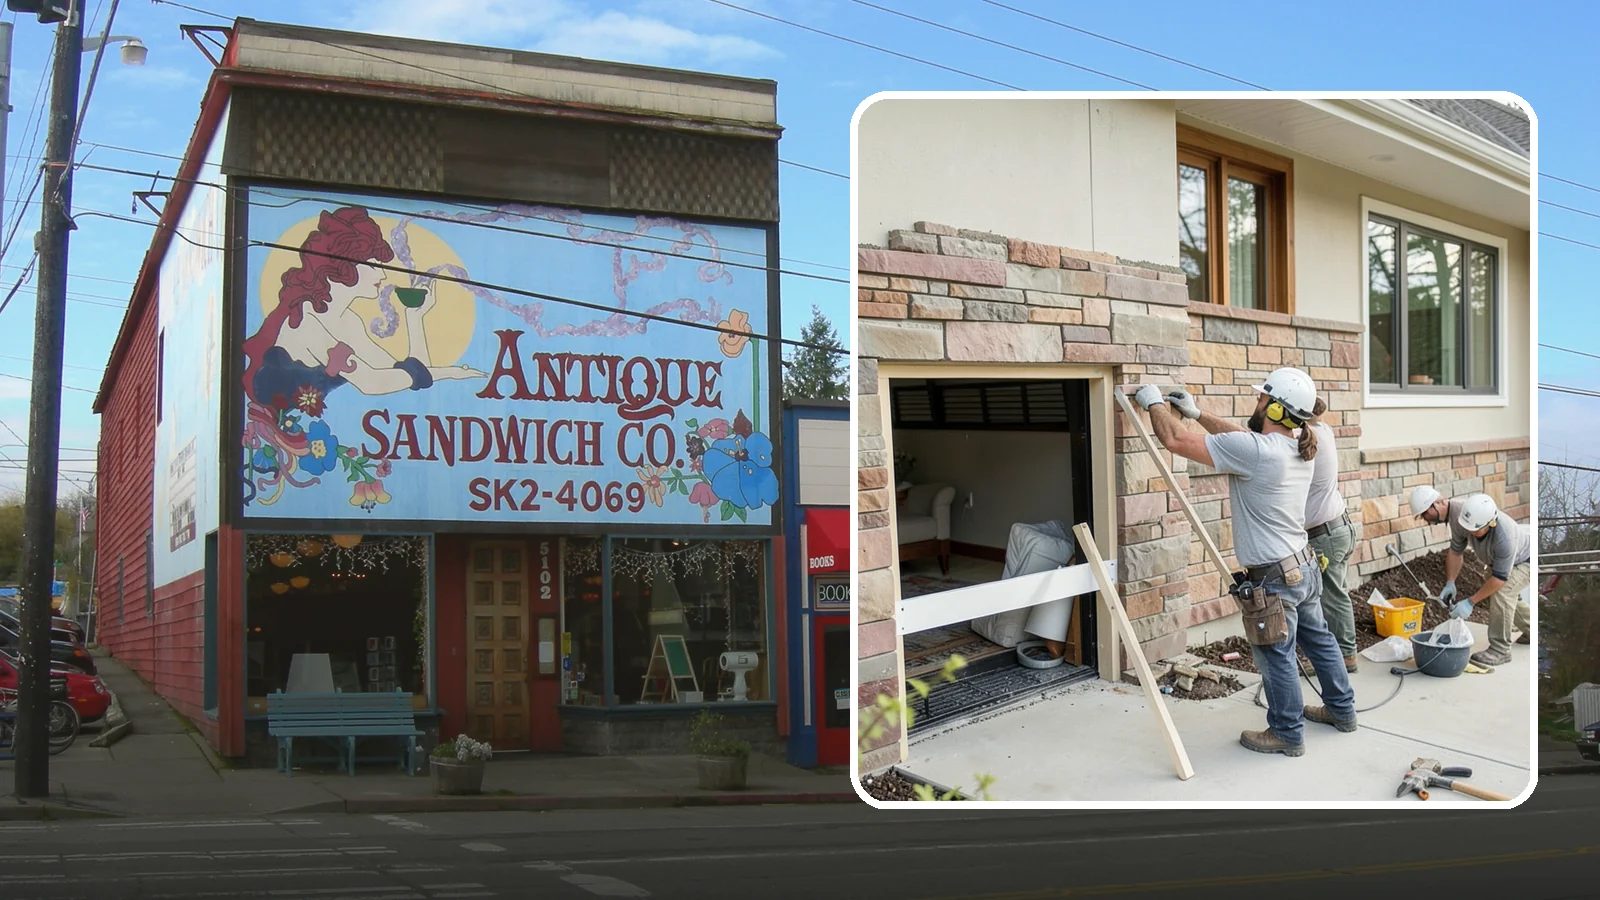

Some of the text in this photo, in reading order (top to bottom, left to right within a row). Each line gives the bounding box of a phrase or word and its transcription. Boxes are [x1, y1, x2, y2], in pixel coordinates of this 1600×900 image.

[475, 329, 723, 421] ANTIQUE
[360, 409, 685, 469] SANDWICH CO.
[468, 477, 646, 513] SK2-4069
[540, 541, 551, 600] 5102
[809, 555, 835, 569] BOOKS
